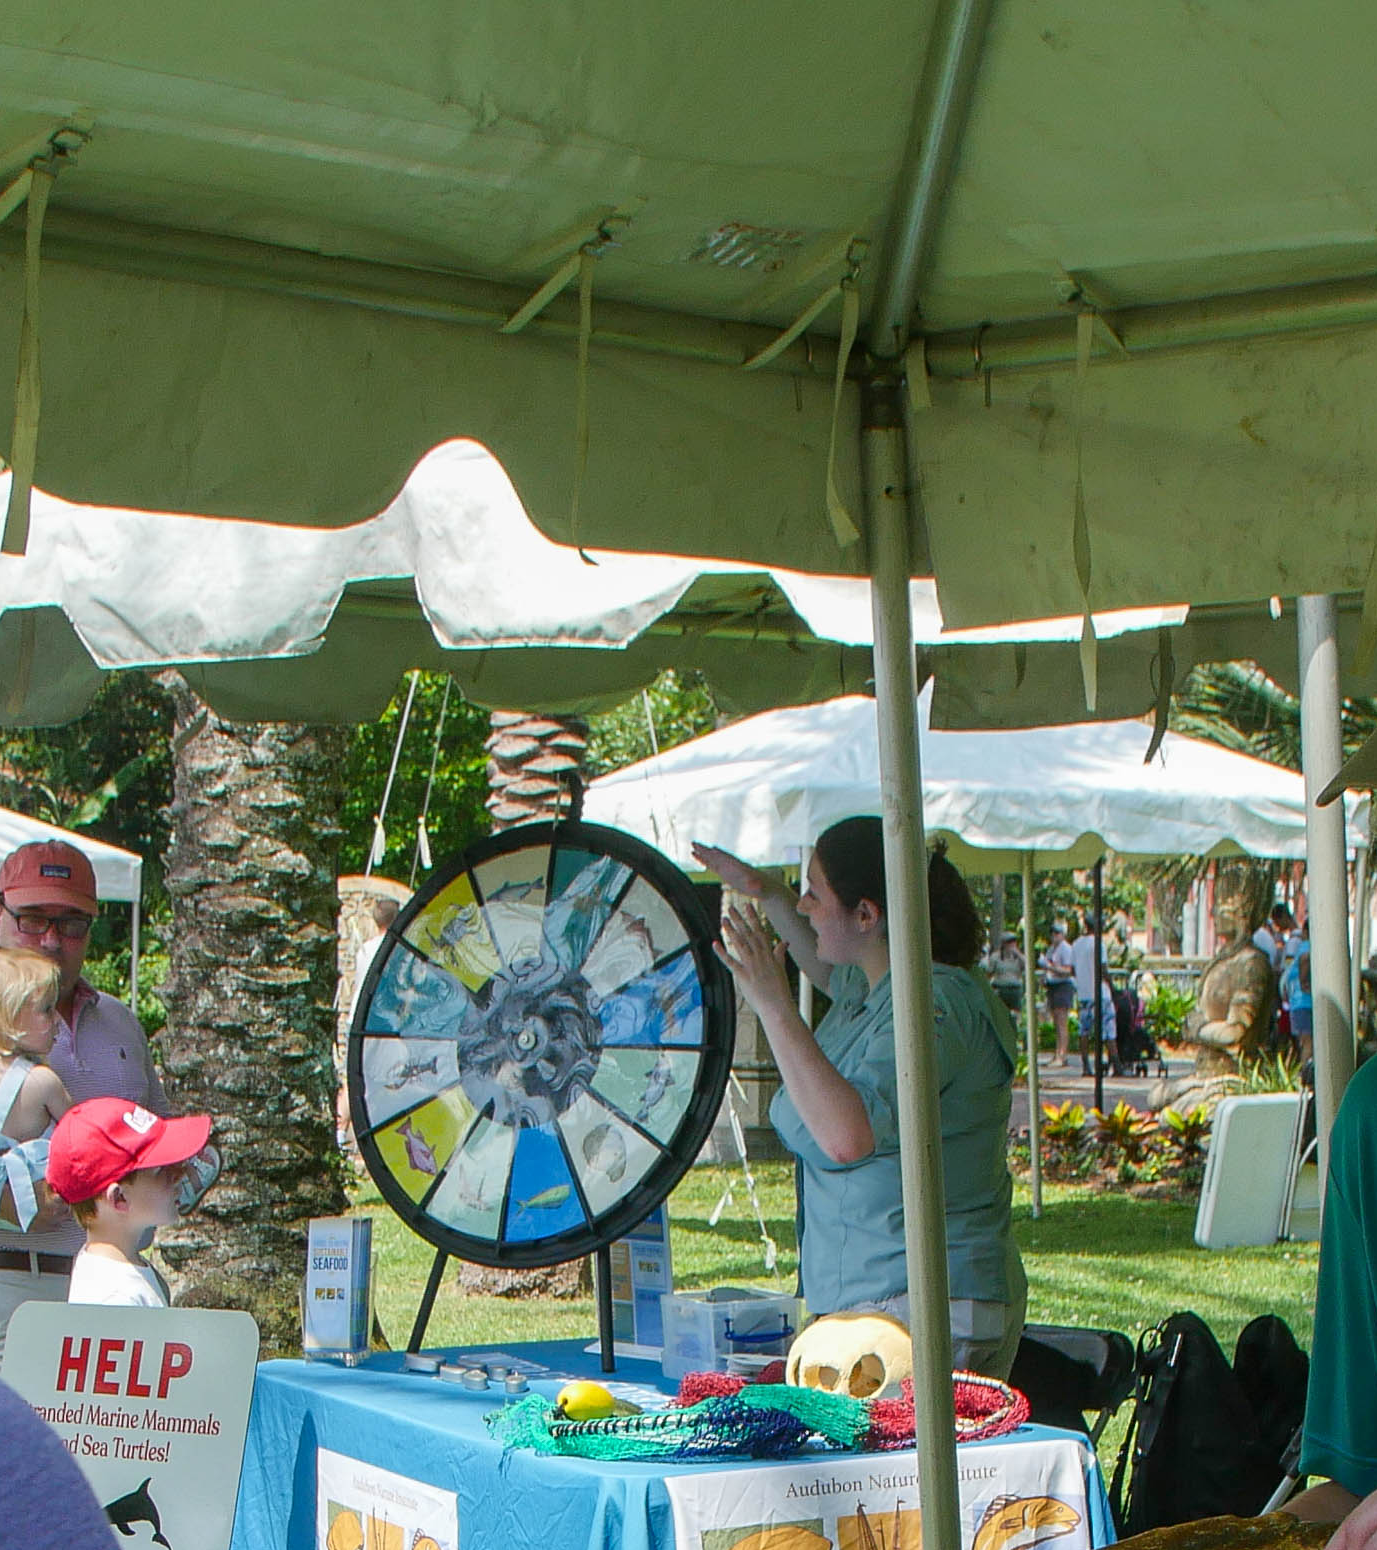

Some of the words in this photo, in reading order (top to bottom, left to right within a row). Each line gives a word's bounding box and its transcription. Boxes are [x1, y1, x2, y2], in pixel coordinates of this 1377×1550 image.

[313, 1257, 348, 1271] SEAFOOD
[56, 1336, 193, 1399] HELP
[32, 1402, 82, 1425] randed
[86, 1405, 139, 1429] Marine
[142, 1409, 221, 1435] Mammals
[61, 1433, 79, 1454] nd
[82, 1435, 108, 1457] Sea
[113, 1436, 171, 1463] Turtles!
[786, 1477, 863, 1499] Audubon
[960, 1465, 997, 1481] itute
